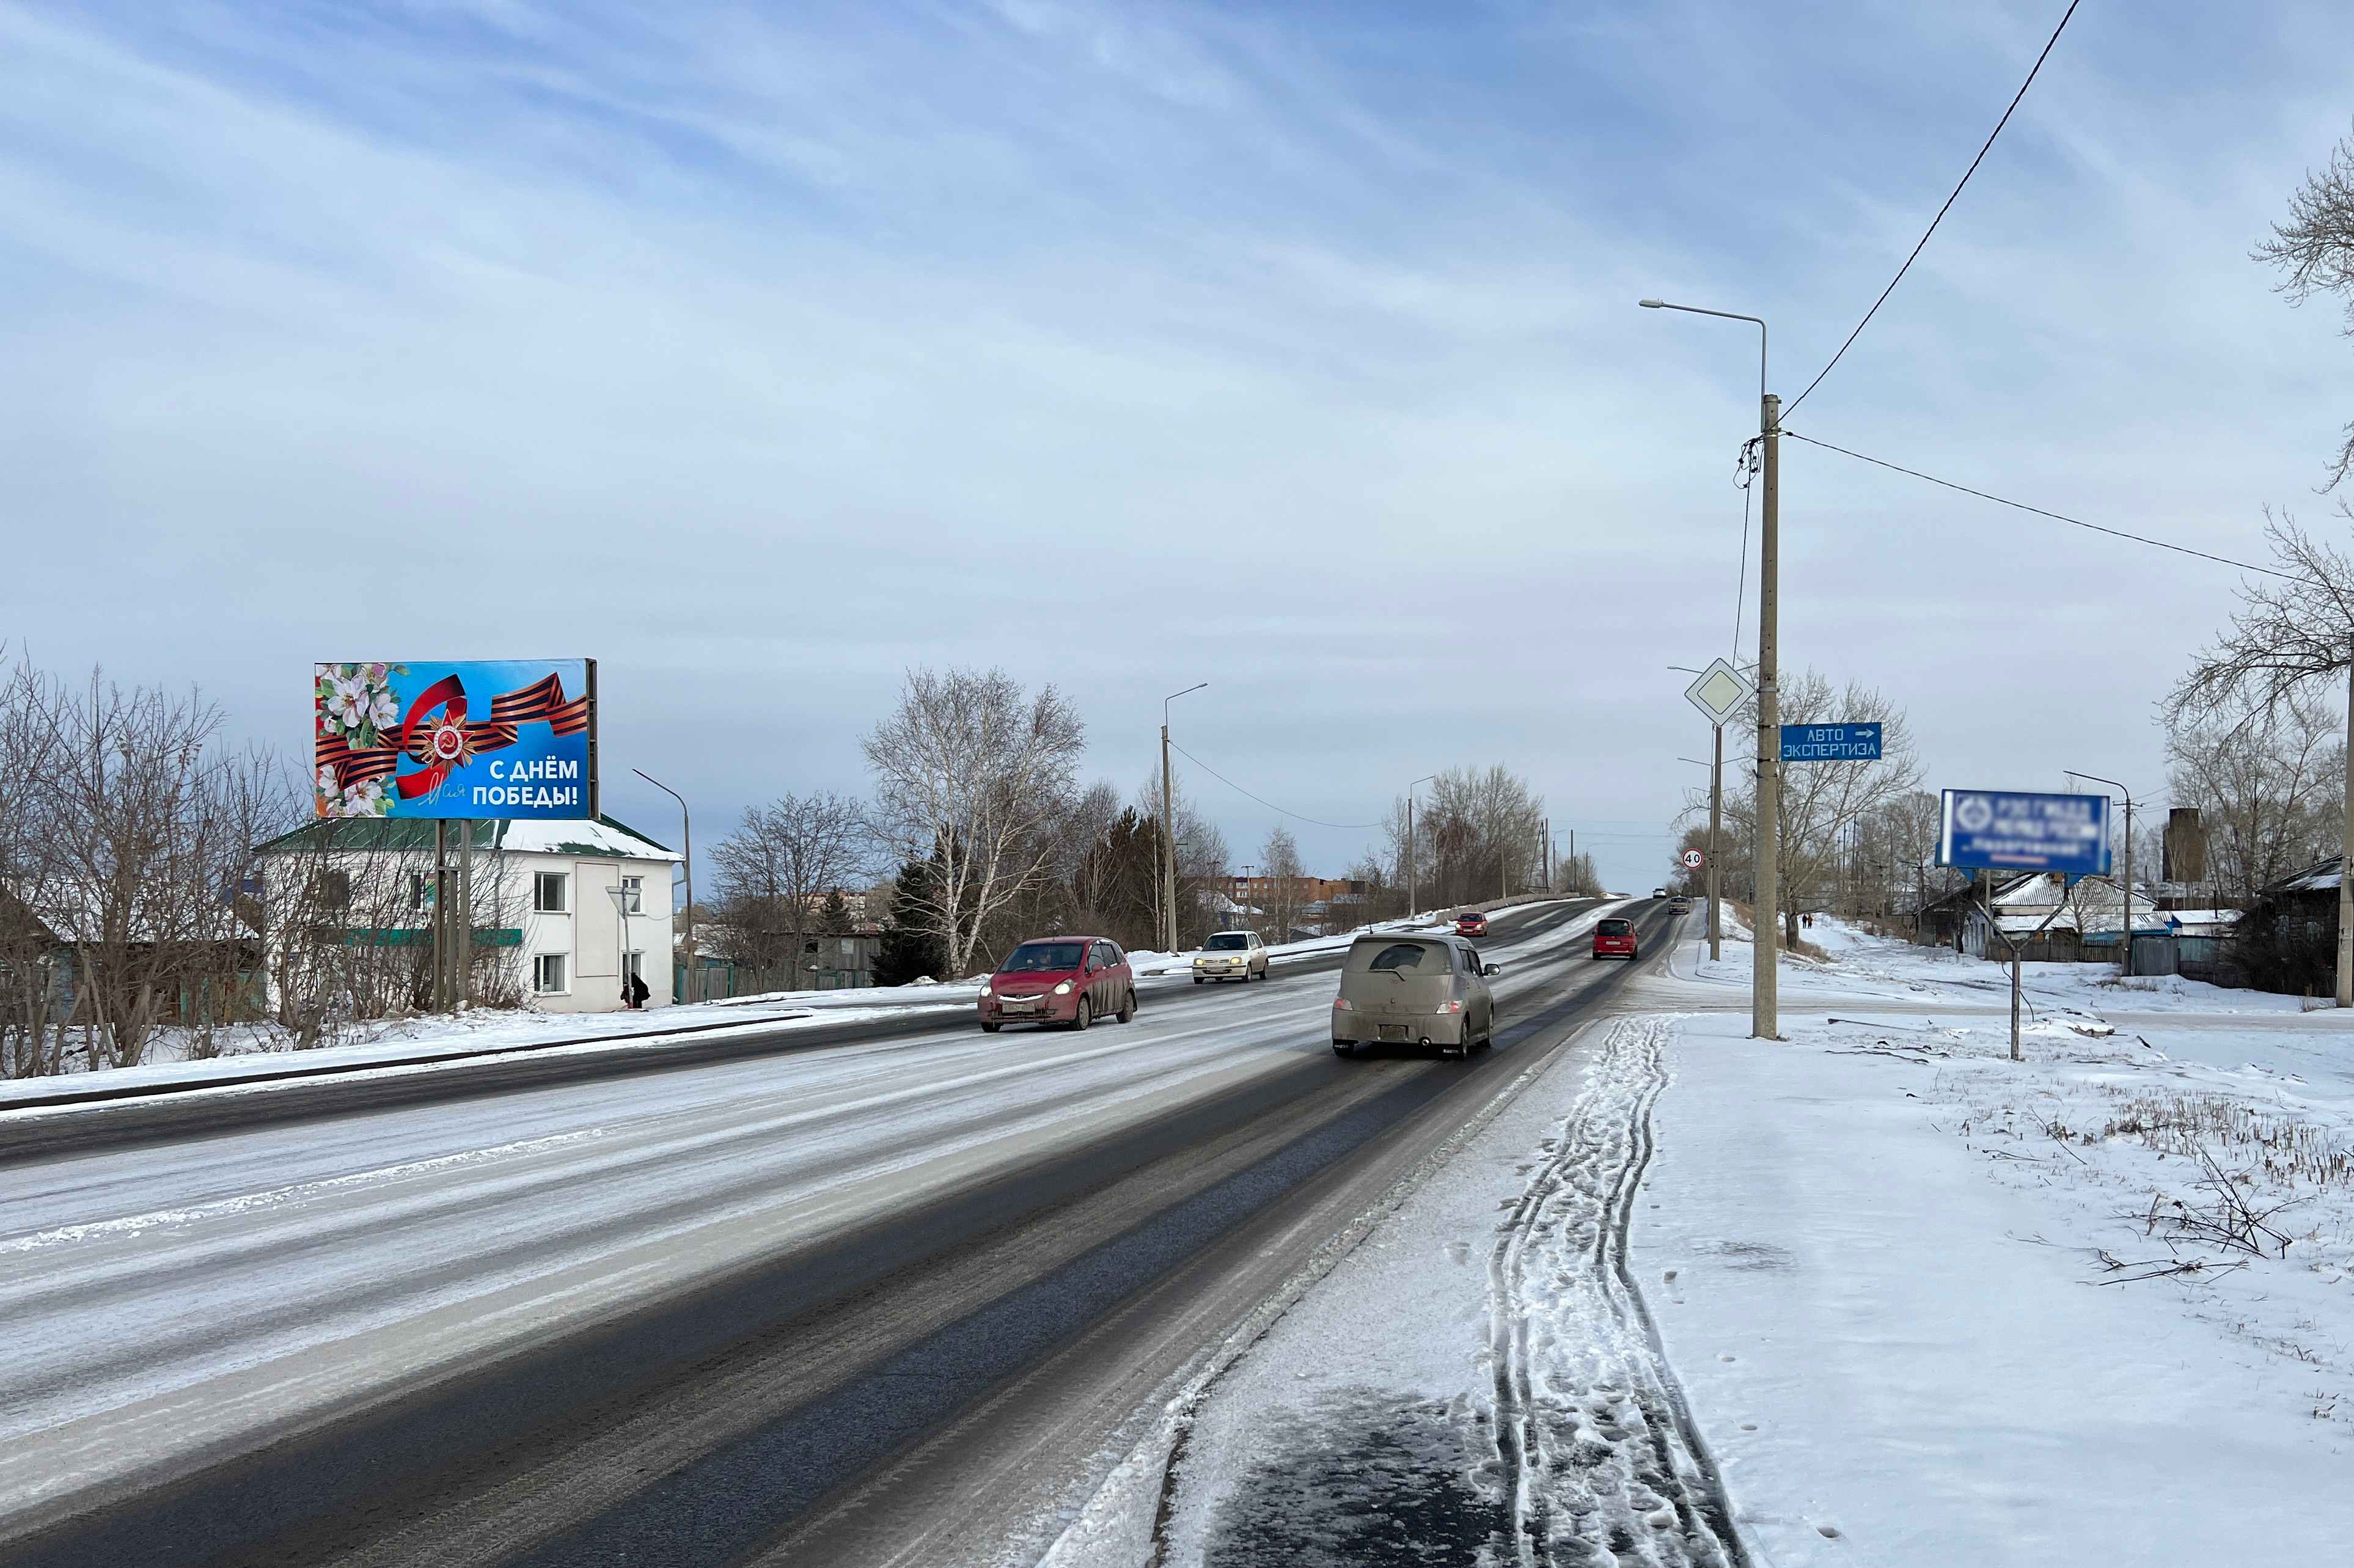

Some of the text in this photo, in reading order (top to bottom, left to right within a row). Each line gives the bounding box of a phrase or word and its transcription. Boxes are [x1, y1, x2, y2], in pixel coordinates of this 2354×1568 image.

[1806, 728, 1844, 742] АВТО
[1783, 742, 1876, 757] ЭКСПЕРТИЗА
[490, 755, 578, 782] С ДНЁМ
[473, 786, 578, 808] ПОБЕДЫ!
[1685, 854, 1700, 863] 40
